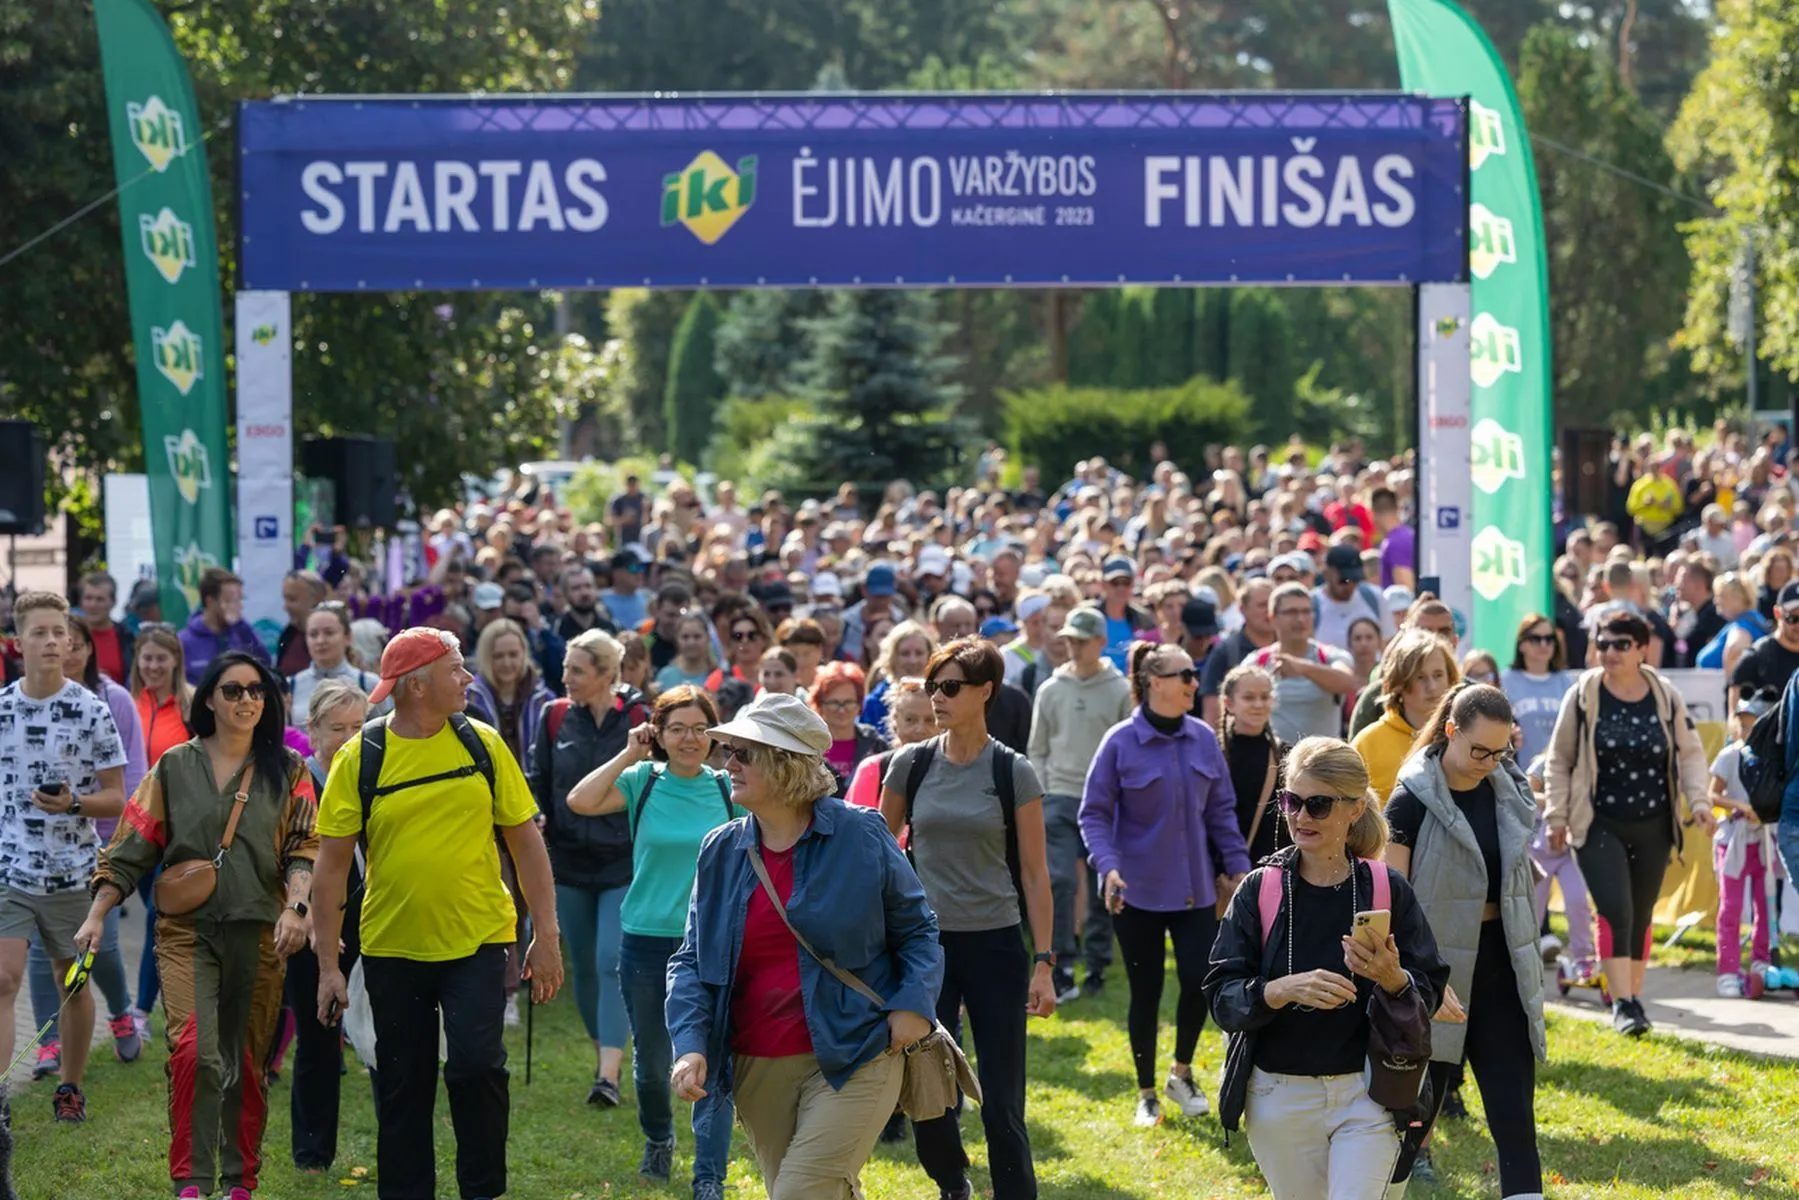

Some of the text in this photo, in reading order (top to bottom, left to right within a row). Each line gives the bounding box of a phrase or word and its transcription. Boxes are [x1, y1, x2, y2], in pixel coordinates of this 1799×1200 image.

[301, 158, 608, 234] STARTAS
[661, 153, 758, 226] iki
[793, 147, 941, 227] ĖJIMO
[948, 151, 1097, 196] VARŽYBOS
[1144, 137, 1415, 228] FINIŠAS
[1056, 207, 1094, 225] 2023
